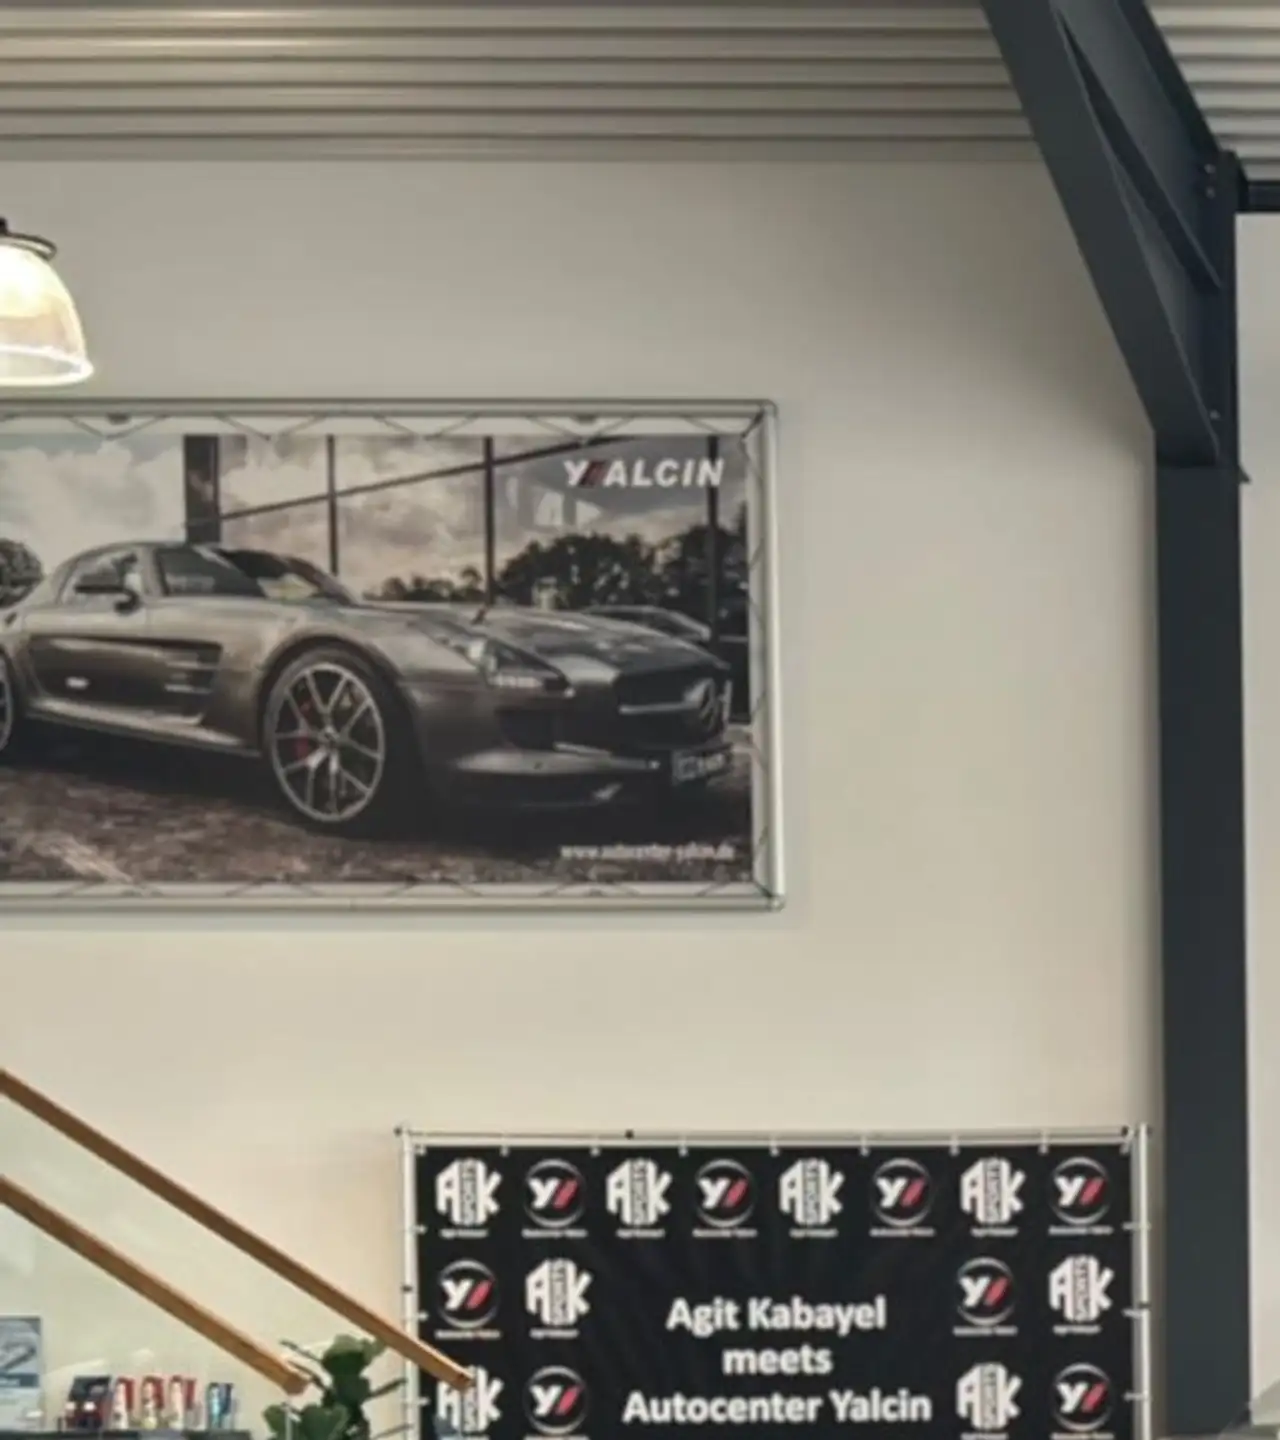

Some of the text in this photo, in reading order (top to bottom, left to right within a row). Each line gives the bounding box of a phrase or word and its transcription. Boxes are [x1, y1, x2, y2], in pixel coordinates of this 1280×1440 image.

[563, 457, 725, 487] YALCIN
[665, 1294, 887, 1337] Agit Kabayel
[721, 1343, 834, 1375] meets
[622, 1387, 932, 1423] Autocenter Yalcin
